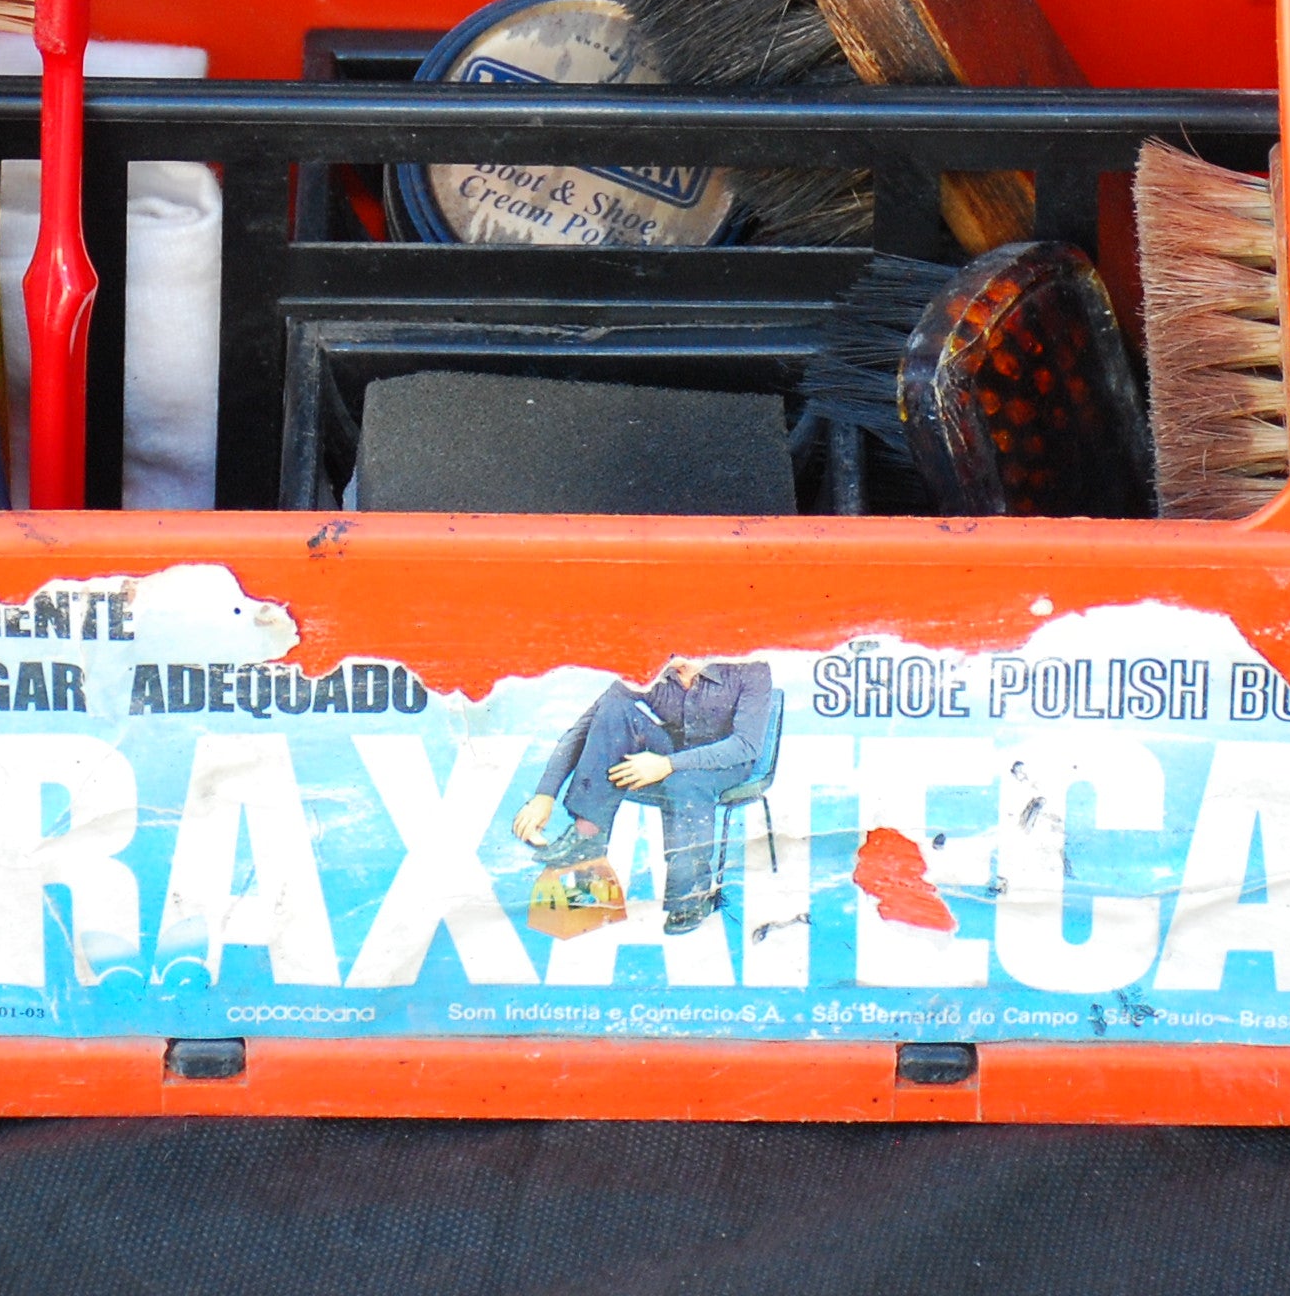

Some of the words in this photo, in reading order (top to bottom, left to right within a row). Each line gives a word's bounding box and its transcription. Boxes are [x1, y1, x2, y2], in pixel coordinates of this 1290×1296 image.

[459, 175, 552, 227] Cream
[549, 179, 576, 205] &
[584, 191, 658, 235] Shoe
[129, 664, 428, 718] ADEQUADO
[812, 656, 970, 717] SHOE
[989, 658, 1209, 720] POLISH
[227, 1005, 375, 1024] copacabana
[448, 1003, 496, 1021] Som
[505, 1002, 601, 1022] Indústria
[609, 1009, 623, 1022] e
[630, 1004, 733, 1024] Comércio
[812, 1004, 853, 1024] São
[861, 1004, 960, 1025] Bernardo
[968, 1008, 996, 1025] do
[1003, 1007, 1079, 1030] Campo
[1153, 1008, 1215, 1027] Paulo
